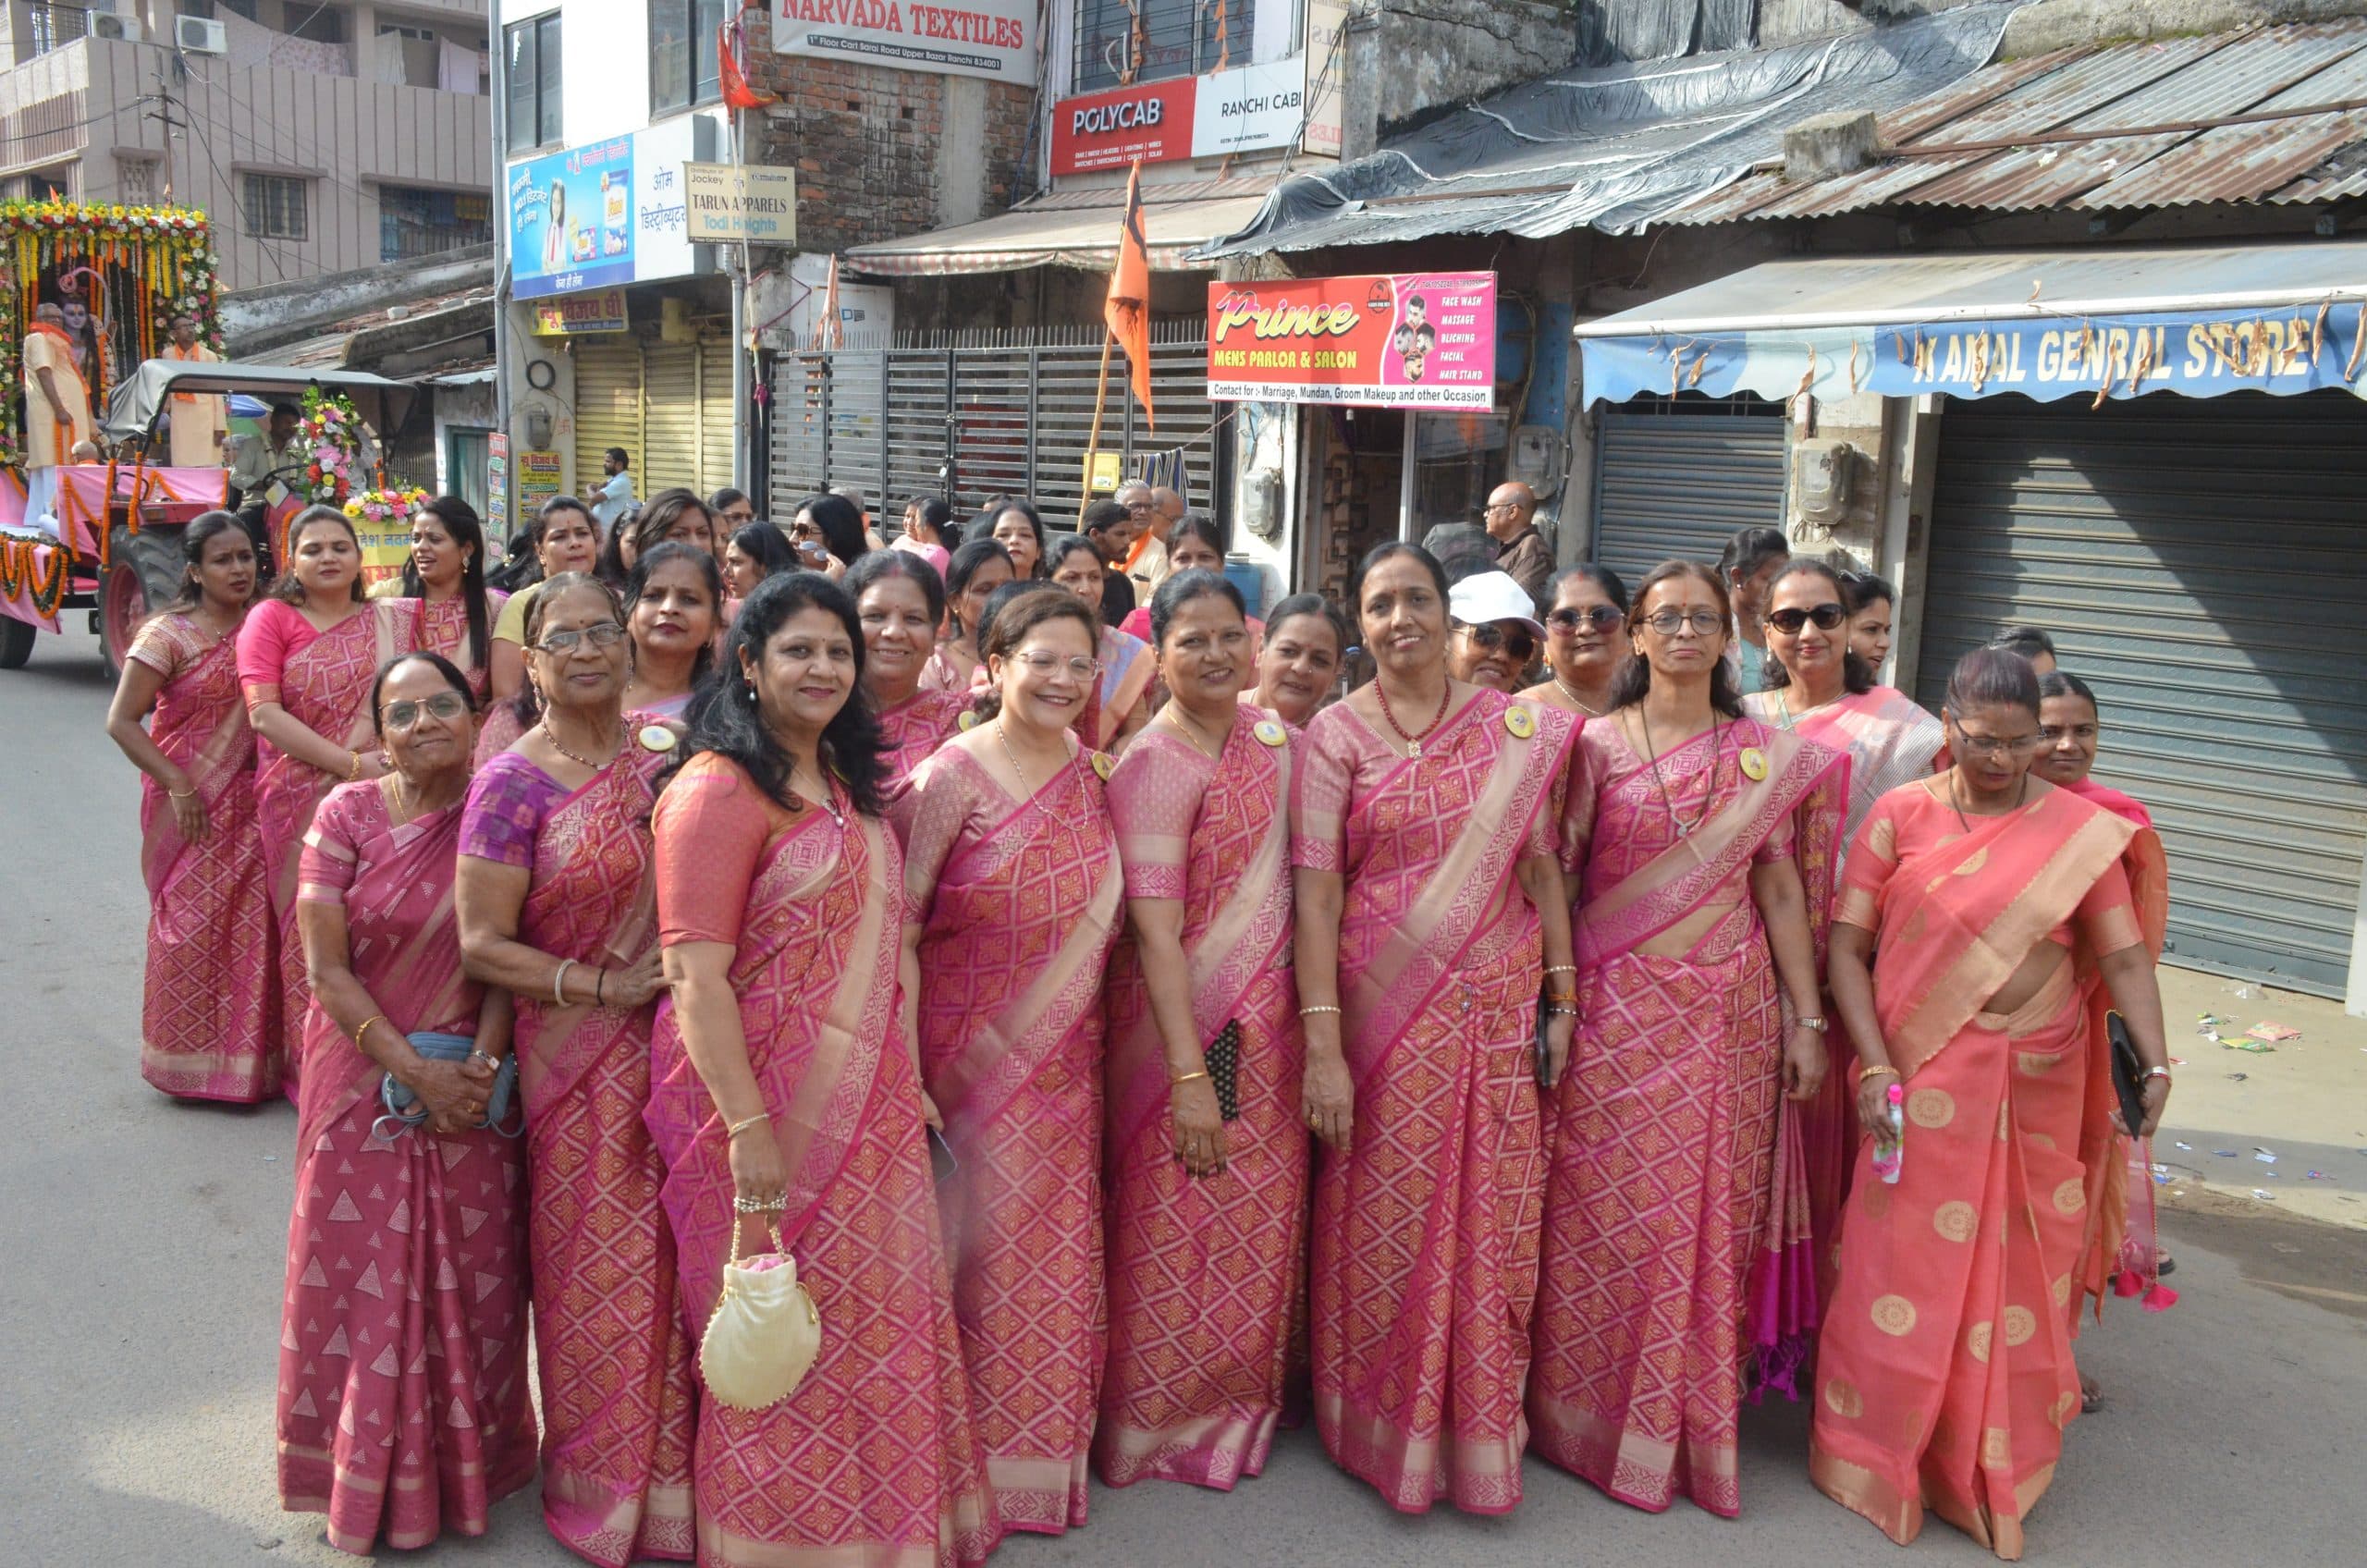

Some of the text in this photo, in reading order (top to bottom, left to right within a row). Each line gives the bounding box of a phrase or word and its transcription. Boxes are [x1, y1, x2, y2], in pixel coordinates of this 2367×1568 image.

[782, 0, 1024, 50] NARVADA TEXTILES
[819, 37, 839, 47] Floor
[840, 40, 858, 50] Cart
[880, 45, 901, 55] Road
[901, 48, 925, 59] Upper
[926, 52, 947, 61] Bazar
[948, 55, 973, 66] Ranchi
[974, 57, 1000, 69] 834001
[1221, 96, 1269, 117] RANCHI
[1073, 97, 1160, 136] POLYCAB
[654, 166, 673, 190] ओम
[692, 175, 724, 185] Jockey
[693, 194, 729, 211] TARUN
[704, 214, 729, 229] Todi
[1441, 296, 1482, 307] FACE WASH
[1216, 290, 1360, 344] Prince
[1441, 315, 1476, 325] MASSAGE
[1441, 334, 1476, 344] BLICHING
[1214, 349, 1356, 369] MENS PARLOR & SALON
[1440, 352, 1465, 361] FACIAL
[2037, 326, 2172, 382] GENRAL
[2184, 319, 2310, 378] STORE
[1439, 370, 1483, 380] HAIR STAND
[1214, 384, 1242, 396] Contact
[1244, 385, 1254, 396] for
[1262, 386, 1297, 400] Marriage,
[1300, 386, 1332, 400] Mundan,
[1335, 387, 1361, 398] Groom
[1364, 387, 1396, 403] Makeup
[1399, 389, 1415, 400] and
[1417, 389, 1441, 401] other
[1443, 389, 1486, 402] Occasion
